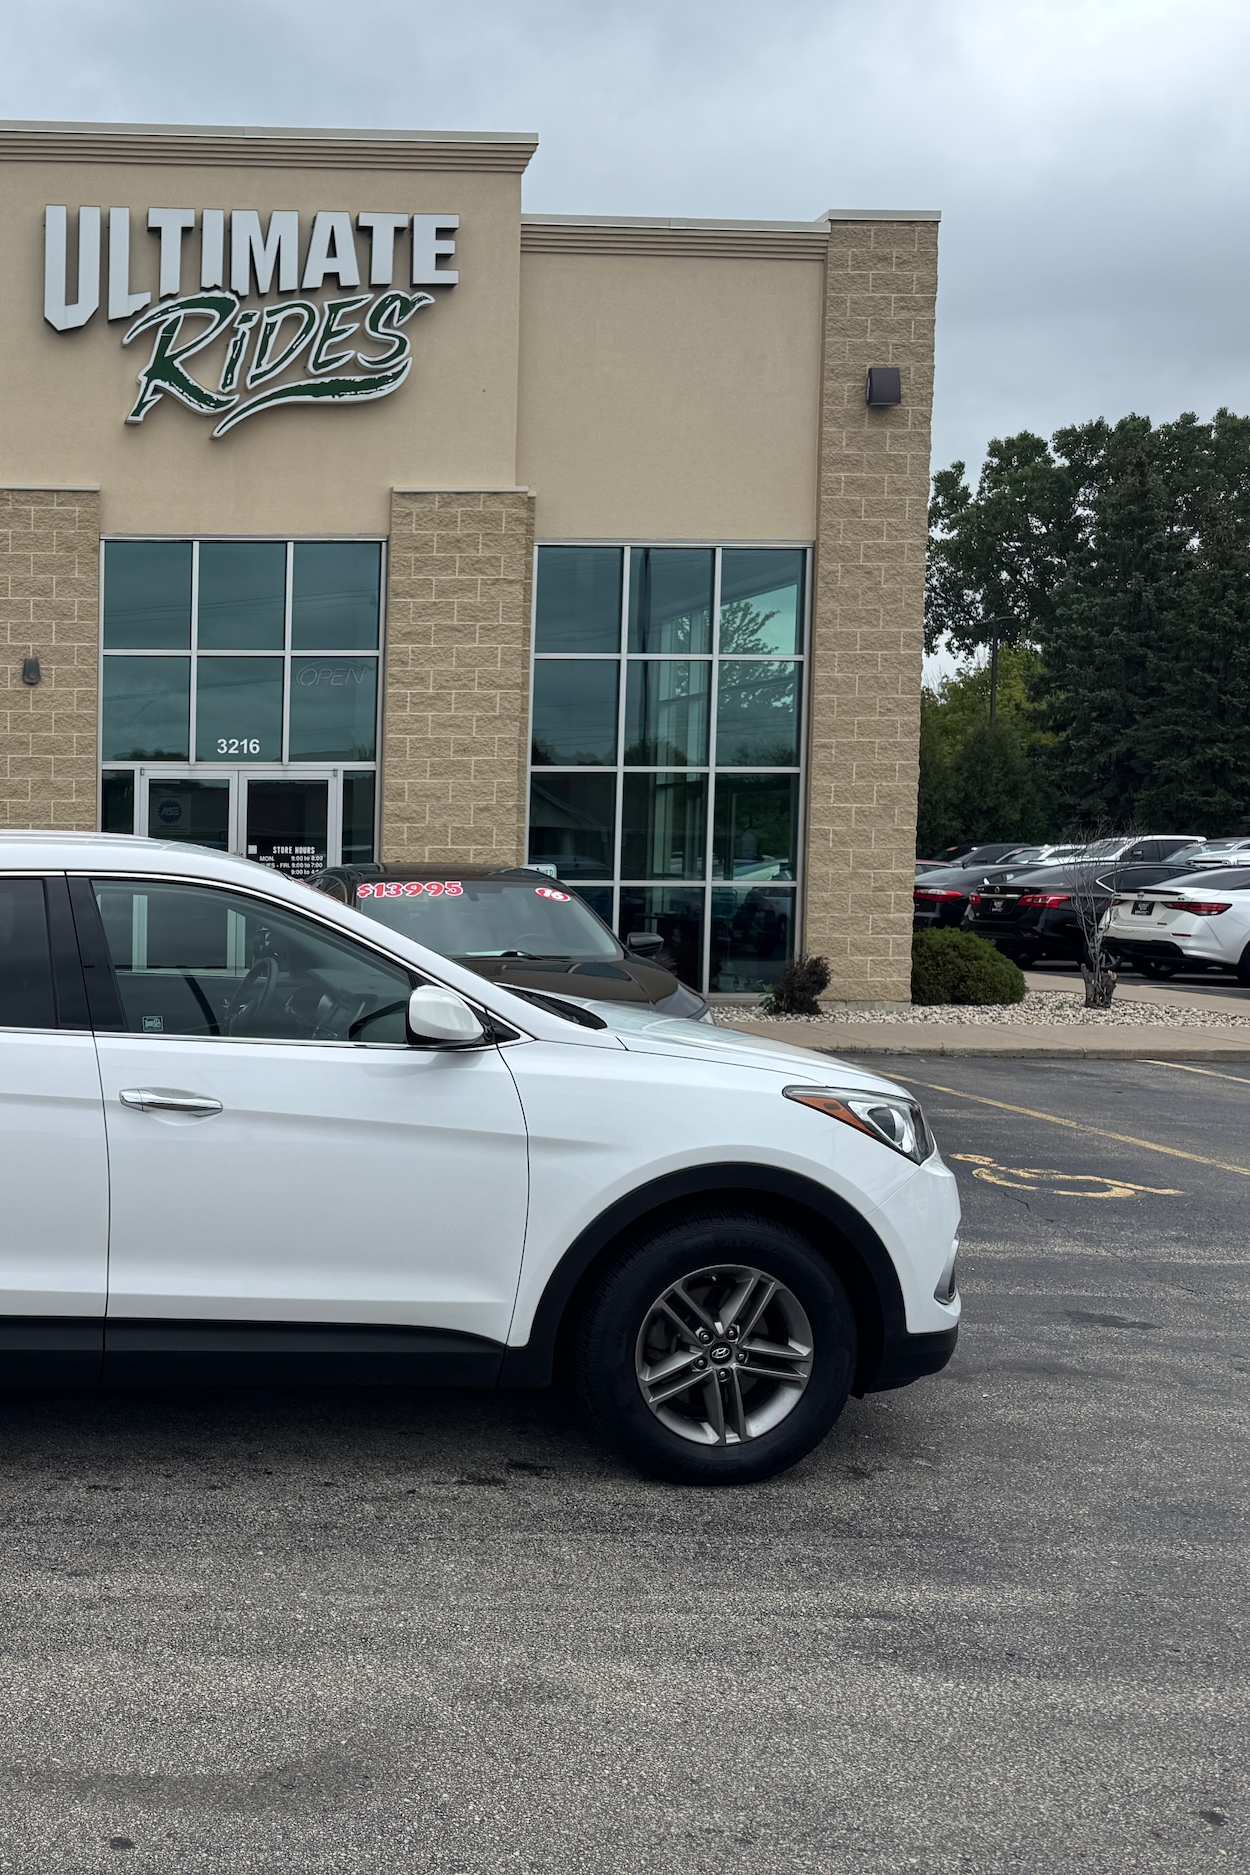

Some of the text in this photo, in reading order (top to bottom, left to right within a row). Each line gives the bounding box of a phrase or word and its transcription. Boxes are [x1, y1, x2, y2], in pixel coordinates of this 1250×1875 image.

[43, 204, 460, 332] ULTIMATE
[300, 667, 367, 686] OPEN
[217, 739, 260, 754] 3216
[272, 846, 316, 854] STORE HOURS
[357, 881, 463, 898] $13995
